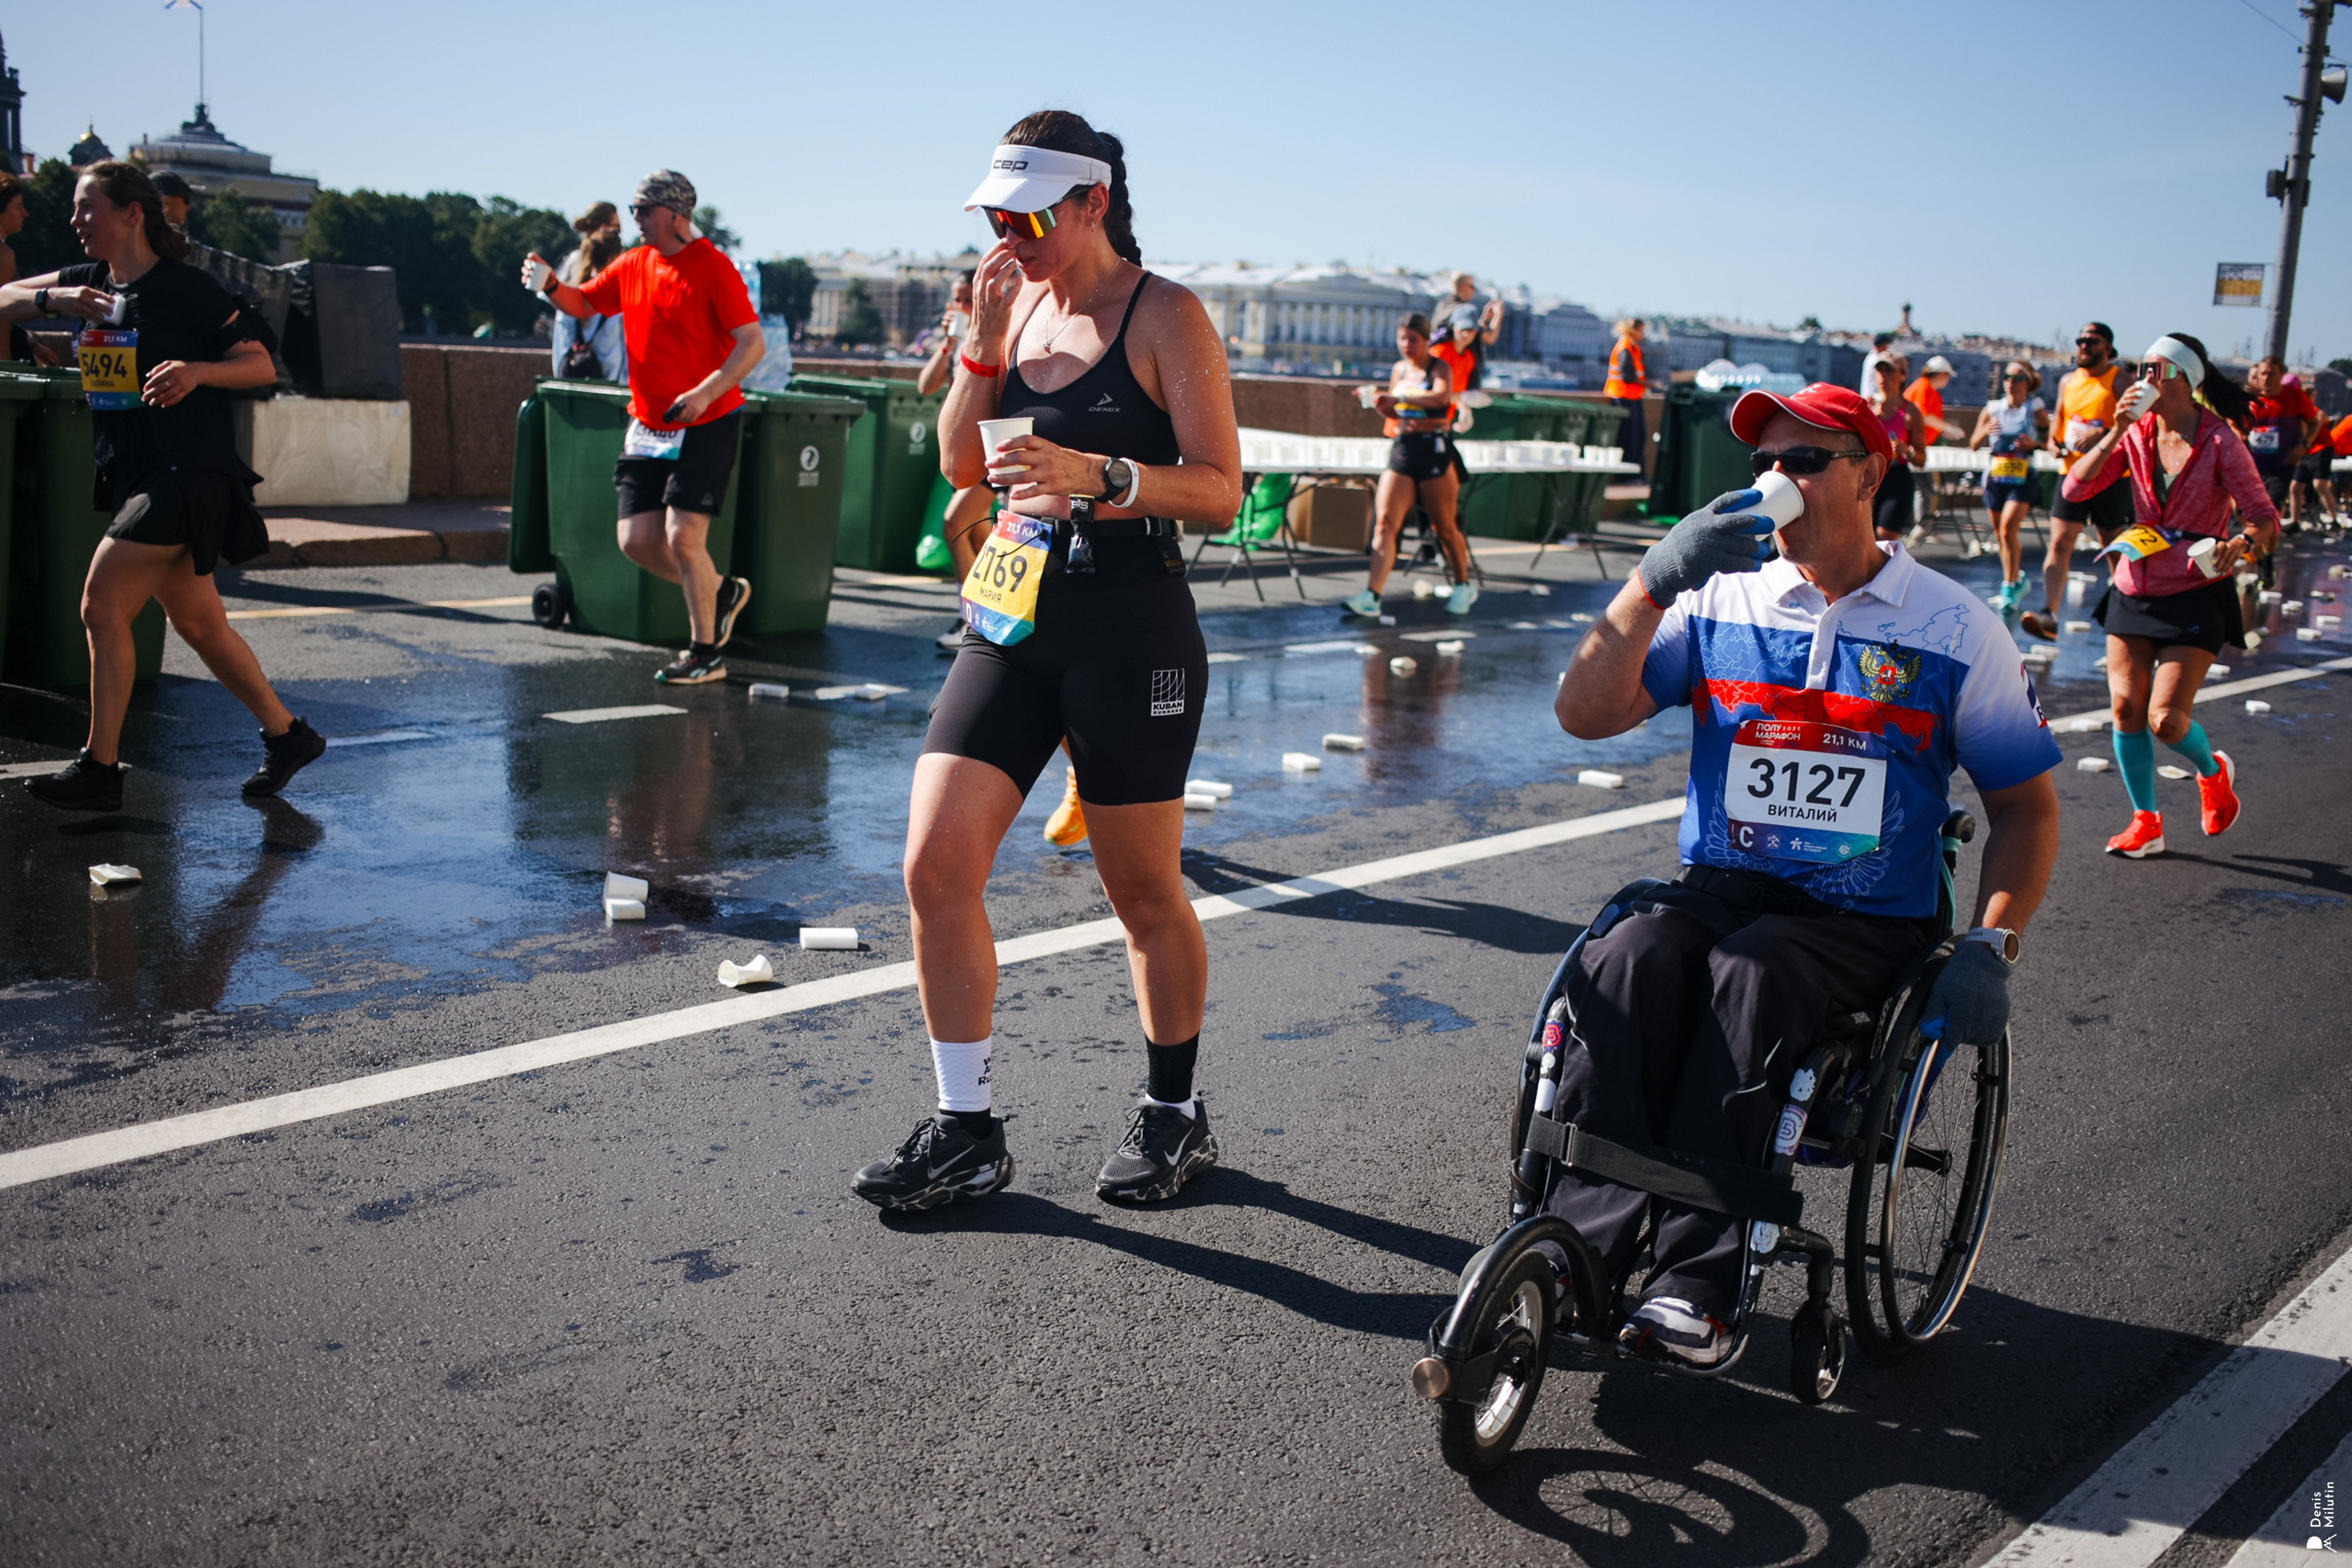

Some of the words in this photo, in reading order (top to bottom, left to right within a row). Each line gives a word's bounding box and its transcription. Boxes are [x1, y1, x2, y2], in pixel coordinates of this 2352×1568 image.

[993, 160, 1029, 173] cep
[81, 353, 128, 378] 5494
[972, 544, 1028, 593] 2769
[979, 587, 1003, 604] МАРИЯ
[1153, 701, 1183, 711] KUBAN
[1756, 722, 1782, 732] ПОЛУ
[1755, 730, 1801, 741] МАРАФОН
[1822, 733, 1845, 746] 21,1
[1747, 758, 1866, 808] 3127
[1768, 804, 1838, 823] ВИТАЛИЙ
